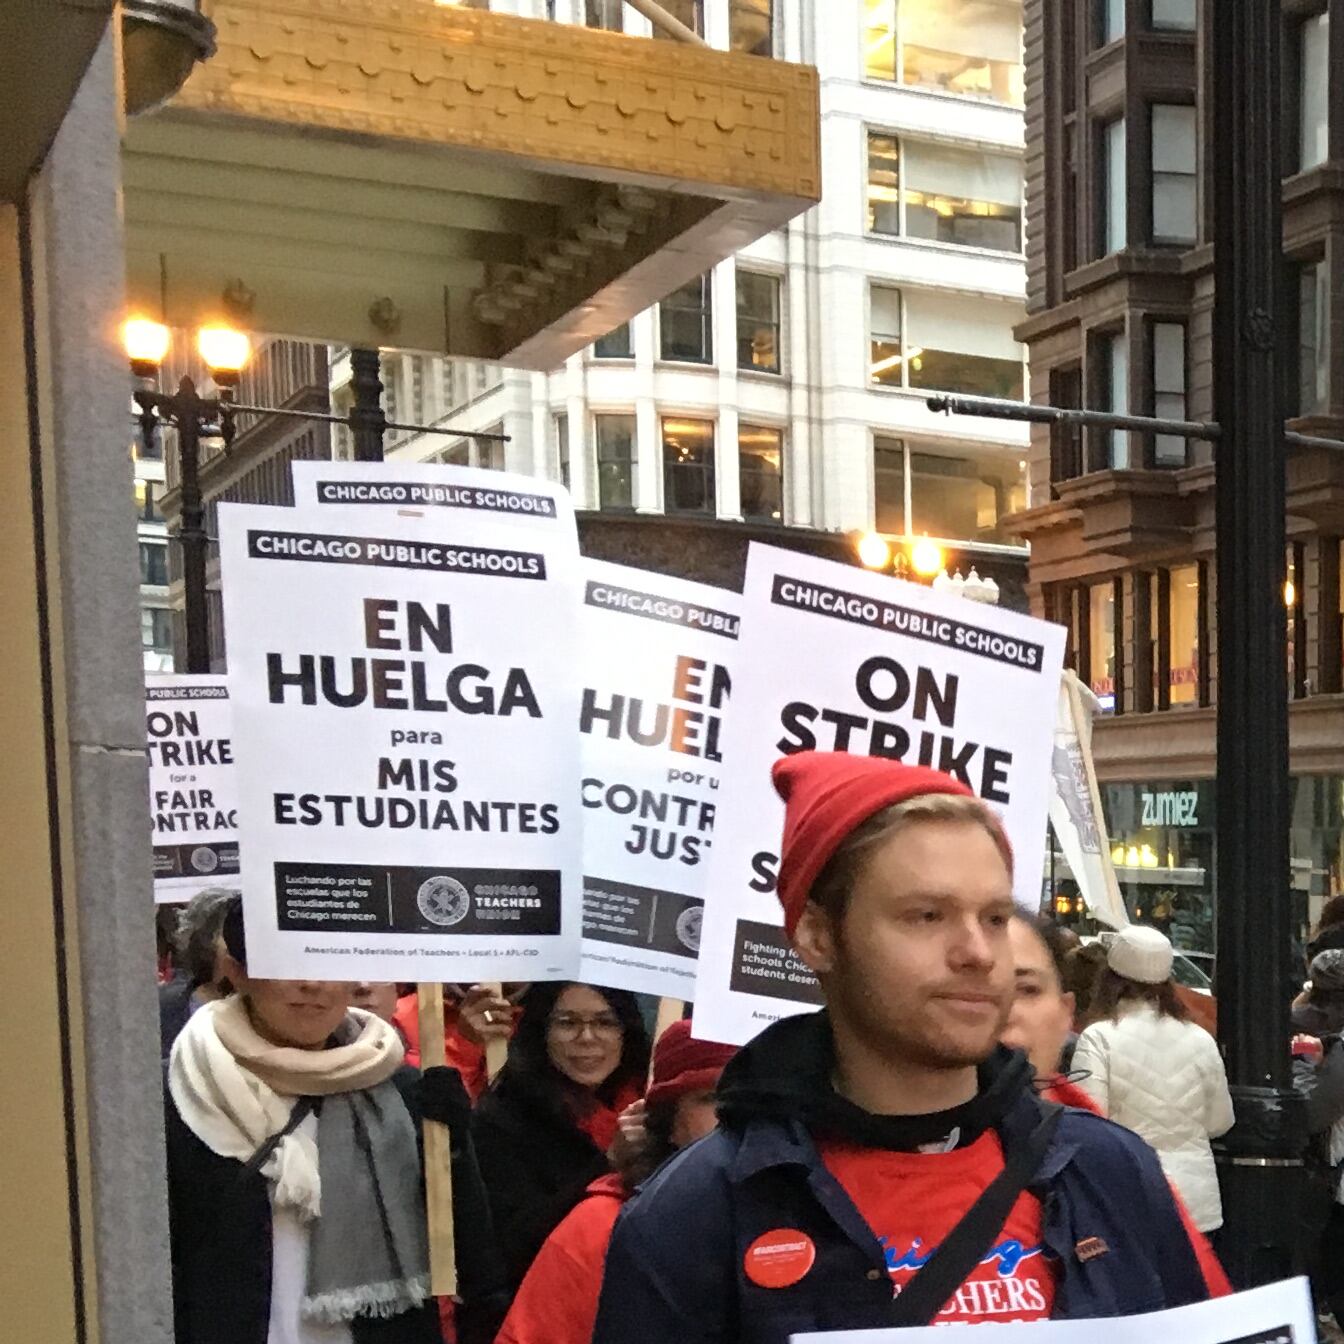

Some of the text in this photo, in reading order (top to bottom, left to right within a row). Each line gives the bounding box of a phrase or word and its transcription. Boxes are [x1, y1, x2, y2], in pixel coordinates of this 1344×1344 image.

[324, 485, 551, 513] CHICAGO PUBLIC SCHOOLS
[256, 536, 539, 574] CHICAGO PUBLIC SCHOOLS
[591, 586, 683, 620] CHICAGO
[363, 598, 453, 654] EN
[780, 583, 1038, 666] CHICAGO PUBLIC SCHOOLS
[266, 653, 543, 718] HUELGA
[855, 655, 959, 729] ON
[147, 711, 199, 738] ON
[390, 728, 442, 747] para
[775, 701, 1014, 804] STRIKE
[170, 774, 187, 783] for
[378, 757, 458, 793] MIS
[667, 768, 706, 788] por
[155, 789, 216, 810] FAIR
[1142, 791, 1198, 826] zumiez
[151, 809, 238, 833] NTRAC
[273, 793, 560, 834] ESTUDIANTES
[624, 824, 712, 866] JUS
[285, 874, 337, 885] Luchando
[338, 878, 356, 886] por
[287, 910, 330, 922] Chicago
[475, 897, 541, 908] TEACHERS
[304, 946, 351, 955] American
[353, 947, 405, 956] Federation
[419, 949, 460, 957] Teachers
[742, 954, 783, 968] schools
[743, 940, 786, 958] Fighting
[741, 966, 785, 981] students
